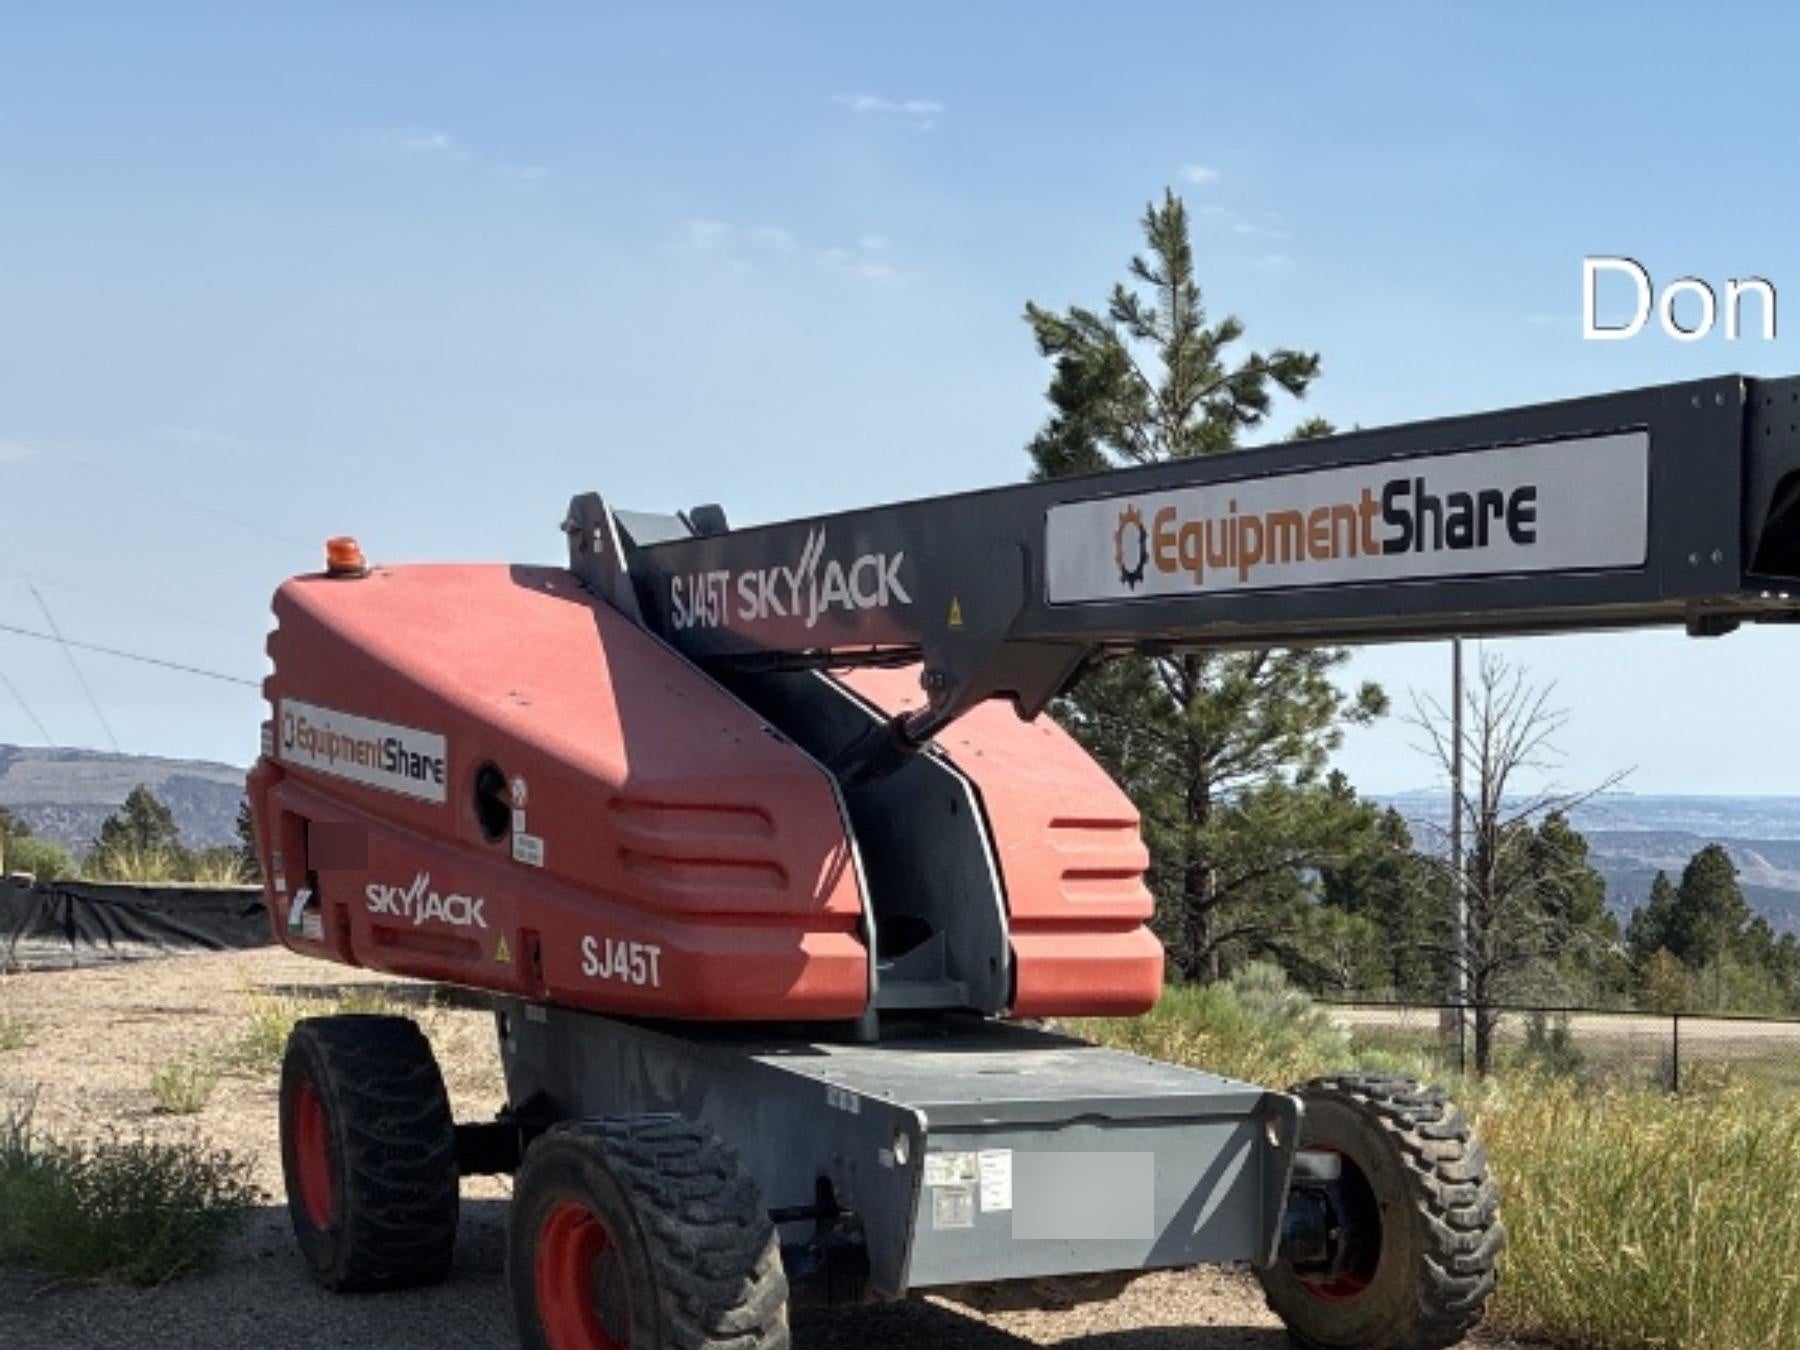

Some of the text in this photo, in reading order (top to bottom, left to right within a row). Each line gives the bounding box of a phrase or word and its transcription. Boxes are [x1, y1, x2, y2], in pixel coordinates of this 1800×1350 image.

[1152, 477, 1537, 585] EquipmentShare
[671, 523, 912, 631] SJ45T SKYJACK
[296, 716, 445, 784] EquipmentShare
[365, 872, 487, 928] SKYJACK
[581, 935, 661, 988] SJ45T
